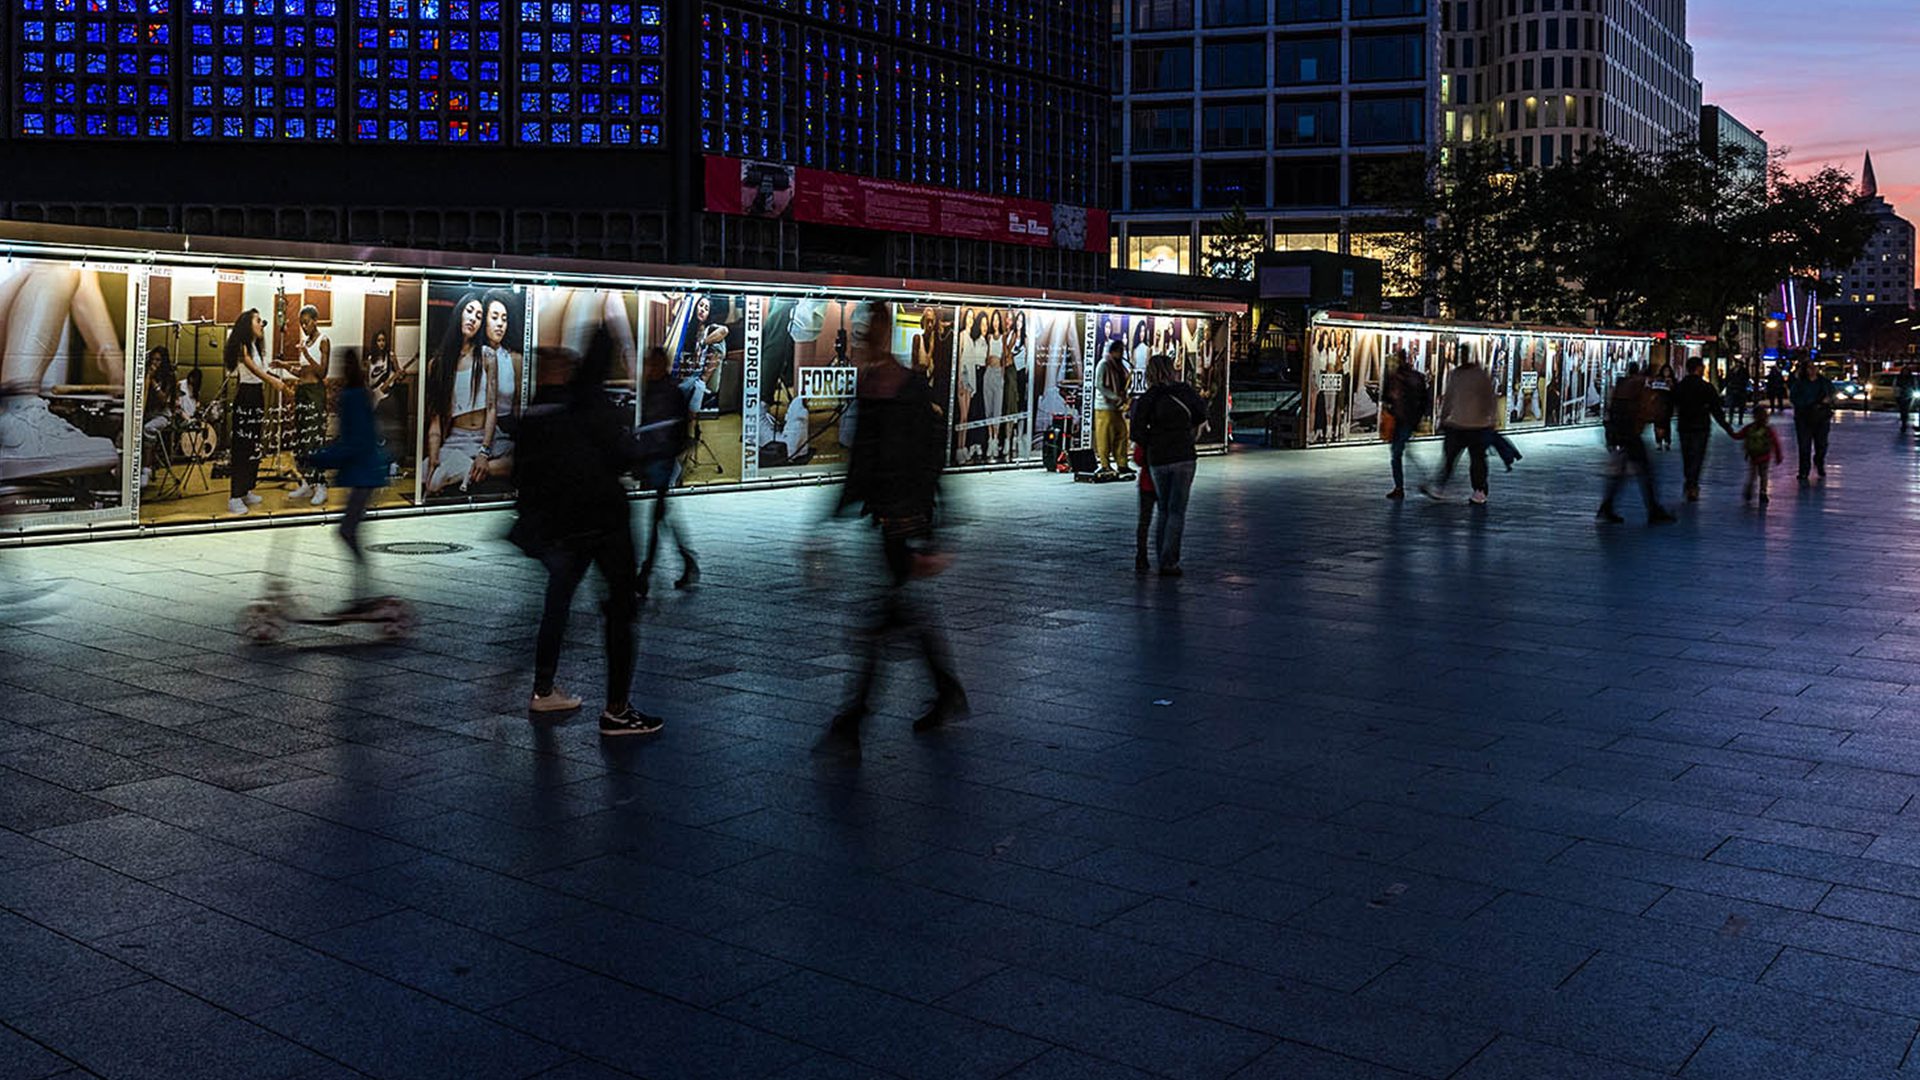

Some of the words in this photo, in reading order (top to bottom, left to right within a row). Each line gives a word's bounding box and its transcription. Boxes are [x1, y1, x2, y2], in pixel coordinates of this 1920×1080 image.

[138, 309, 146, 335] FEMALE
[748, 298, 760, 332] THE
[1084, 314, 1095, 366] FEMALE
[137, 345, 145, 365] FORCE
[747, 336, 759, 388] FORCE
[801, 369, 855, 396] FORCE
[1084, 370, 1093, 382] IS
[1321, 375, 1341, 389] FORCE
[135, 382, 143, 409] FEMALE
[746, 393, 758, 408] IS
[1083, 386, 1092, 426] FORCE
[744, 414, 757, 479] FEMALE
[1082, 430, 1090, 447] HE
[132, 455, 140, 481] FEMALE
